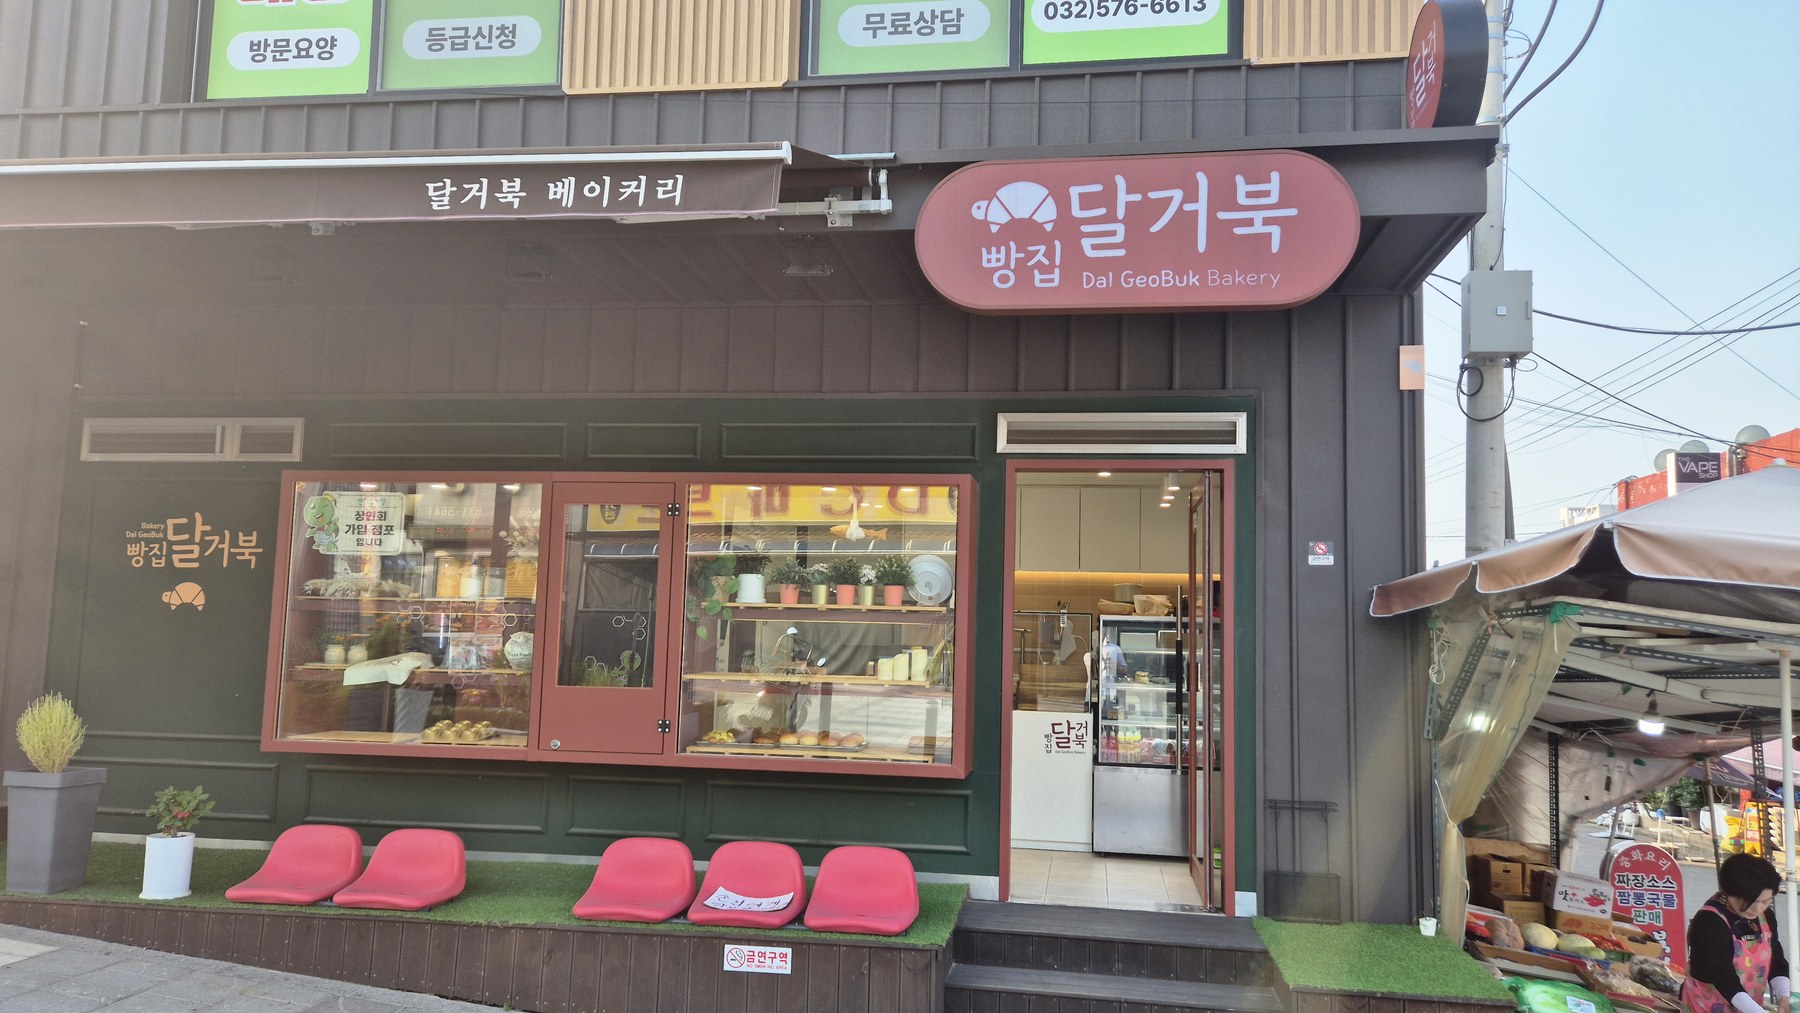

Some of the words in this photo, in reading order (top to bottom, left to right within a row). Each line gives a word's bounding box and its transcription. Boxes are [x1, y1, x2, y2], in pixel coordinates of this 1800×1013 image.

[1044, 0, 1207, 21] 032)576-6613
[862, 8, 965, 40] 무료상담
[425, 23, 518, 52] 등급신청
[249, 36, 338, 63] 방문요양
[425, 178, 527, 211] 달거북
[547, 174, 684, 208] 베이커리
[1069, 171, 1298, 257] 달거북
[982, 240, 1061, 289] 빵집
[1083, 271, 1113, 288] Dal
[1121, 270, 1200, 287] GeoBuk
[1208, 269, 1281, 288] Bakery
[1678, 461, 1718, 473] VAPE
[355, 511, 387, 521] 상인회
[138, 530, 164, 538] GeoBuk
[141, 522, 165, 530] Bakery
[345, 524, 367, 535] 가입
[372, 524, 394, 535] 점포
[166, 512, 263, 569] 달거북
[356, 538, 383, 546] 입니다
[127, 541, 167, 568] 빵집
[1616, 872, 1677, 890] 짜장소스
[1617, 890, 1677, 909] 짬뽕국물
[1633, 909, 1662, 926] 판매
[746, 950, 788, 964] 금연구역
